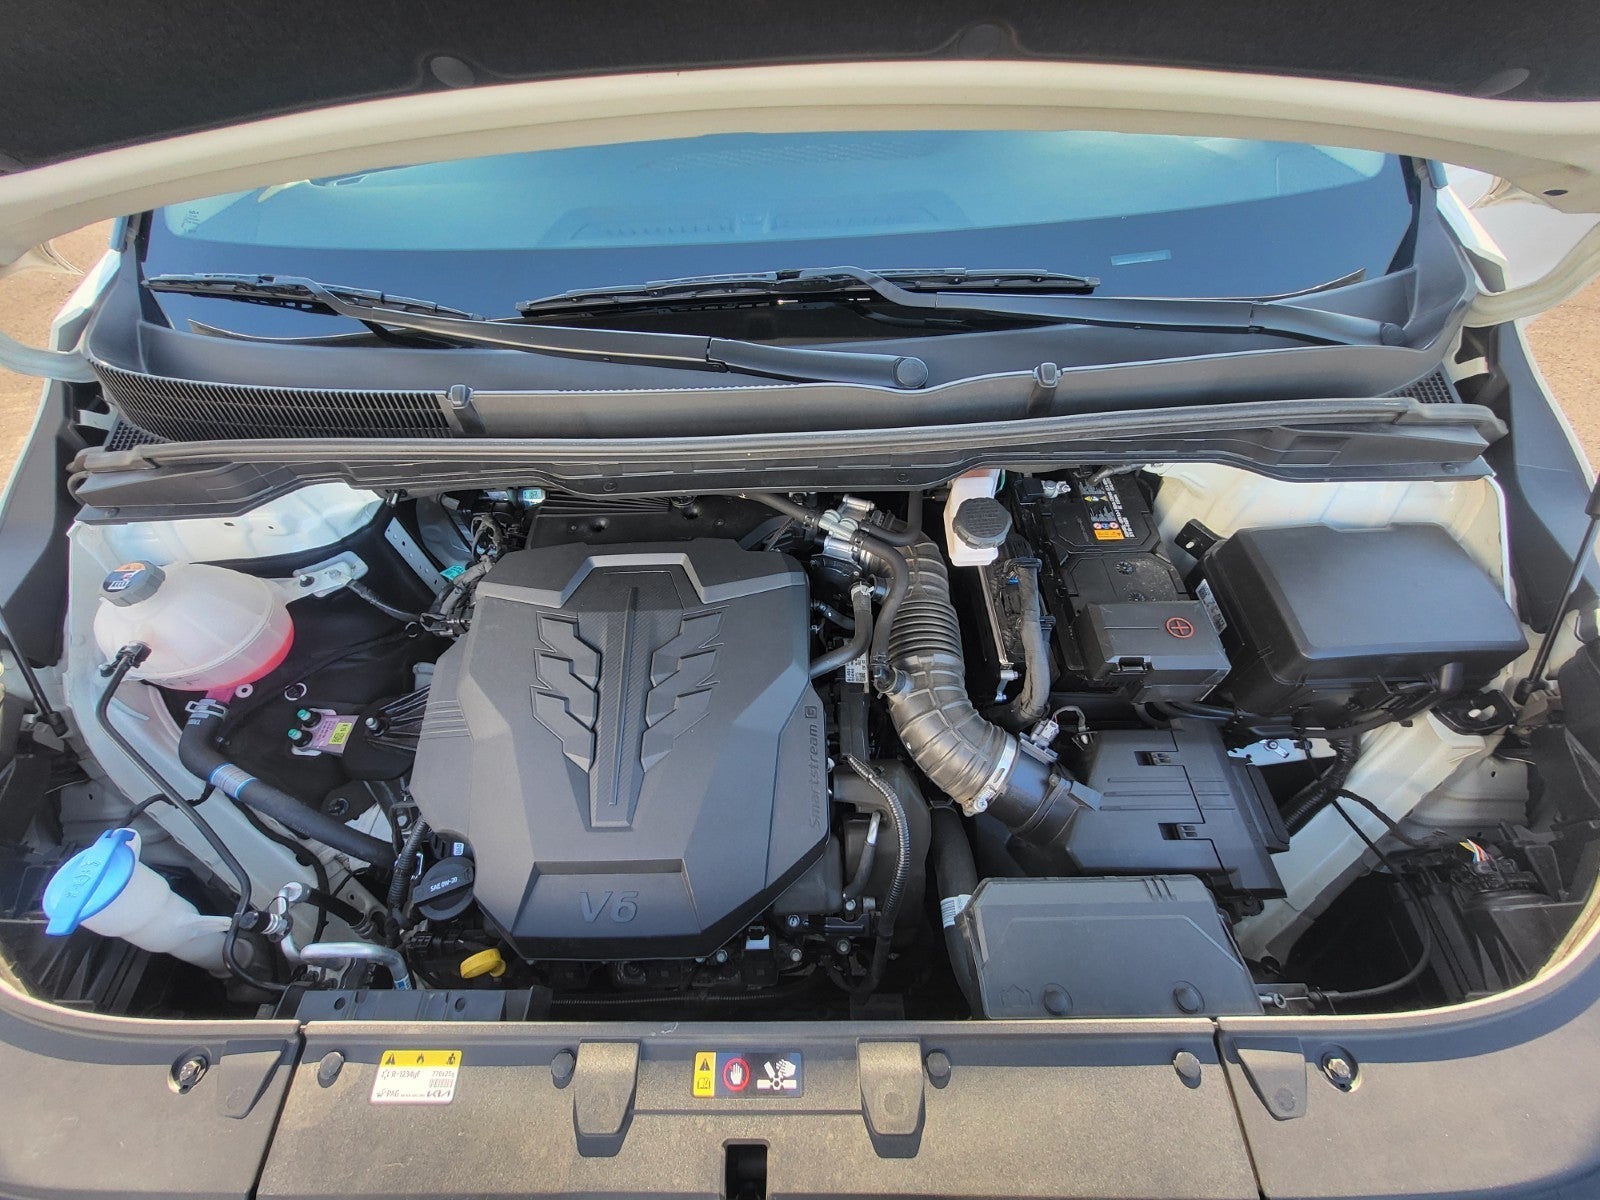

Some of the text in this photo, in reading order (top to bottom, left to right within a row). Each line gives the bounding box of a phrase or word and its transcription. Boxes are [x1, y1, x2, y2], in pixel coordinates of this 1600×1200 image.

[808, 723, 820, 830] Smartstream
[430, 876, 458, 892] SAE 0W-20
[578, 890, 639, 924] V6
